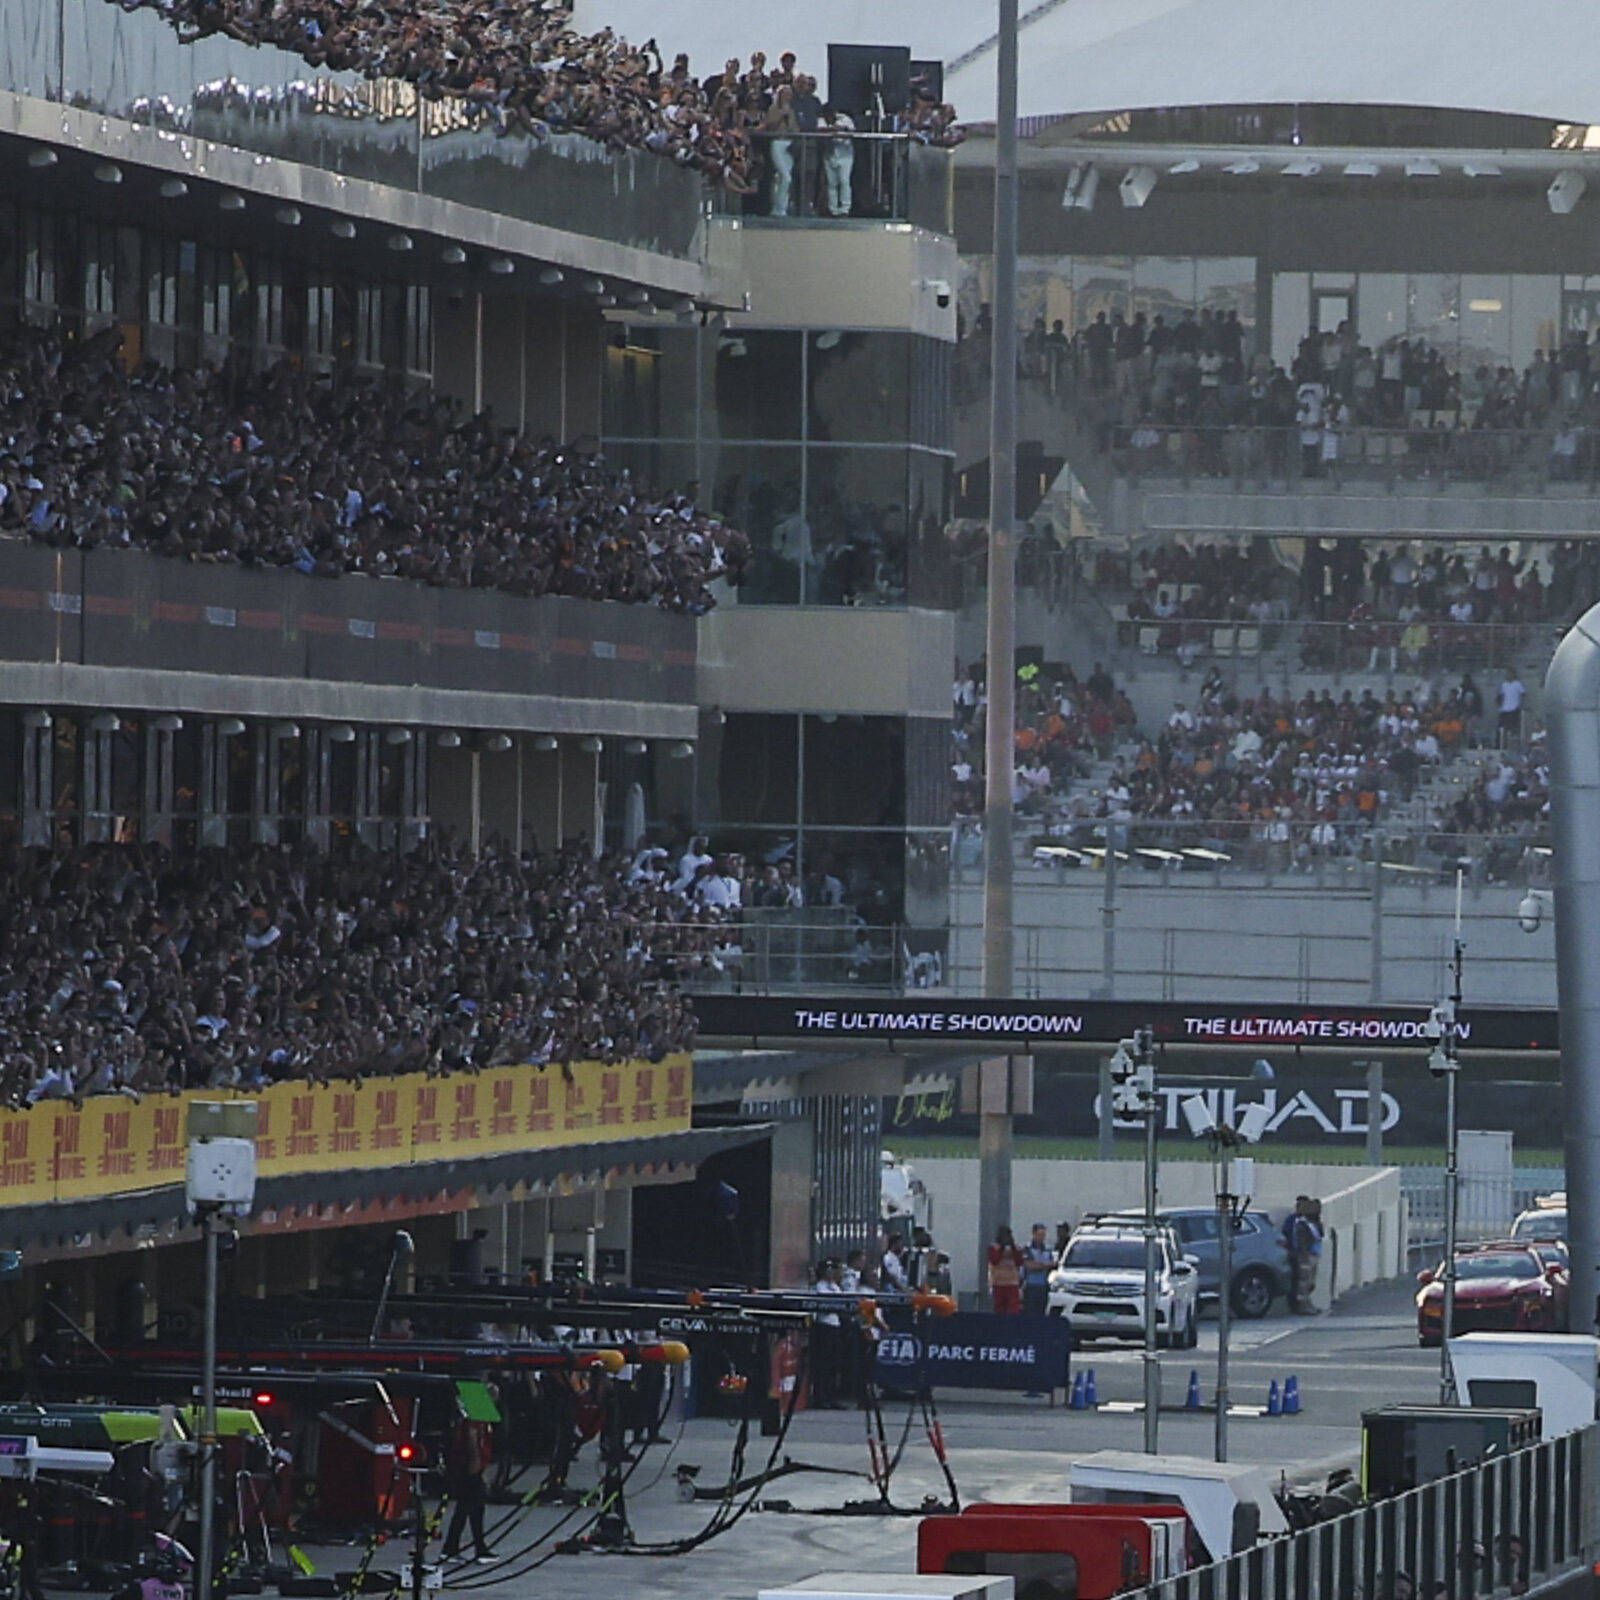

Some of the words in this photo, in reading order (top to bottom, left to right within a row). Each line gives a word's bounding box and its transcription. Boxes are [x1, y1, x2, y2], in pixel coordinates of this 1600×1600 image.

[795, 1011, 836, 1028] THE
[842, 1012, 943, 1031] ULTIMATE
[948, 1014, 1082, 1034] SHOWDOWN
[1185, 1018, 1225, 1035] THE
[1230, 1018, 1331, 1037] ULTIMATE
[1337, 1021, 1470, 1040] SHOWDN
[929, 1344, 970, 1362] PARC
